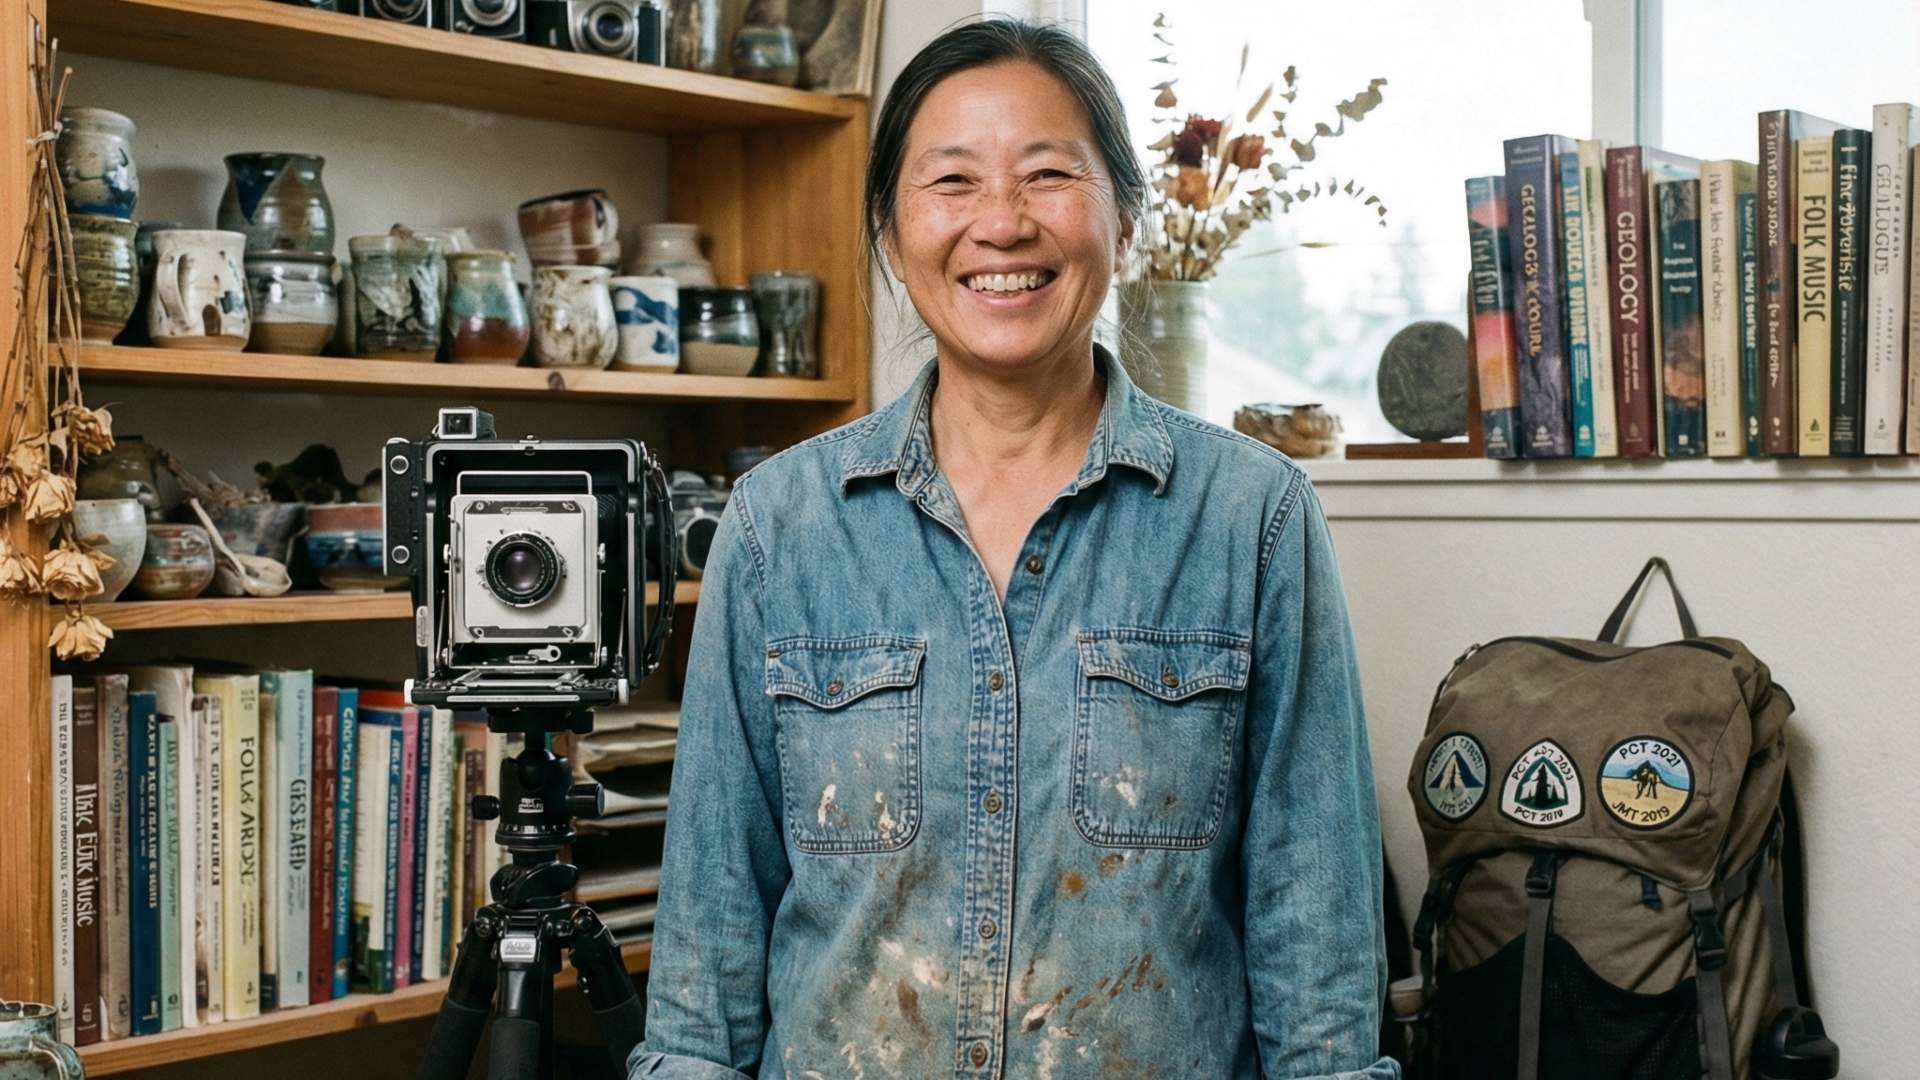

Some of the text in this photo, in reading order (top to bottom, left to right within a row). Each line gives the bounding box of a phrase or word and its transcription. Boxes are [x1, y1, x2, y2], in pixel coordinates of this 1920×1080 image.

[1803, 195, 1827, 249] FOLK
[1617, 211, 1639, 324] GEOLOGY
[1803, 255, 1827, 323] MUSIC
[1619, 742, 1682, 768] PCT 2021
[1511, 756, 1531, 781] PCT
[1514, 806, 1538, 822] PCT
[1611, 801, 1671, 823] JMT 2019
